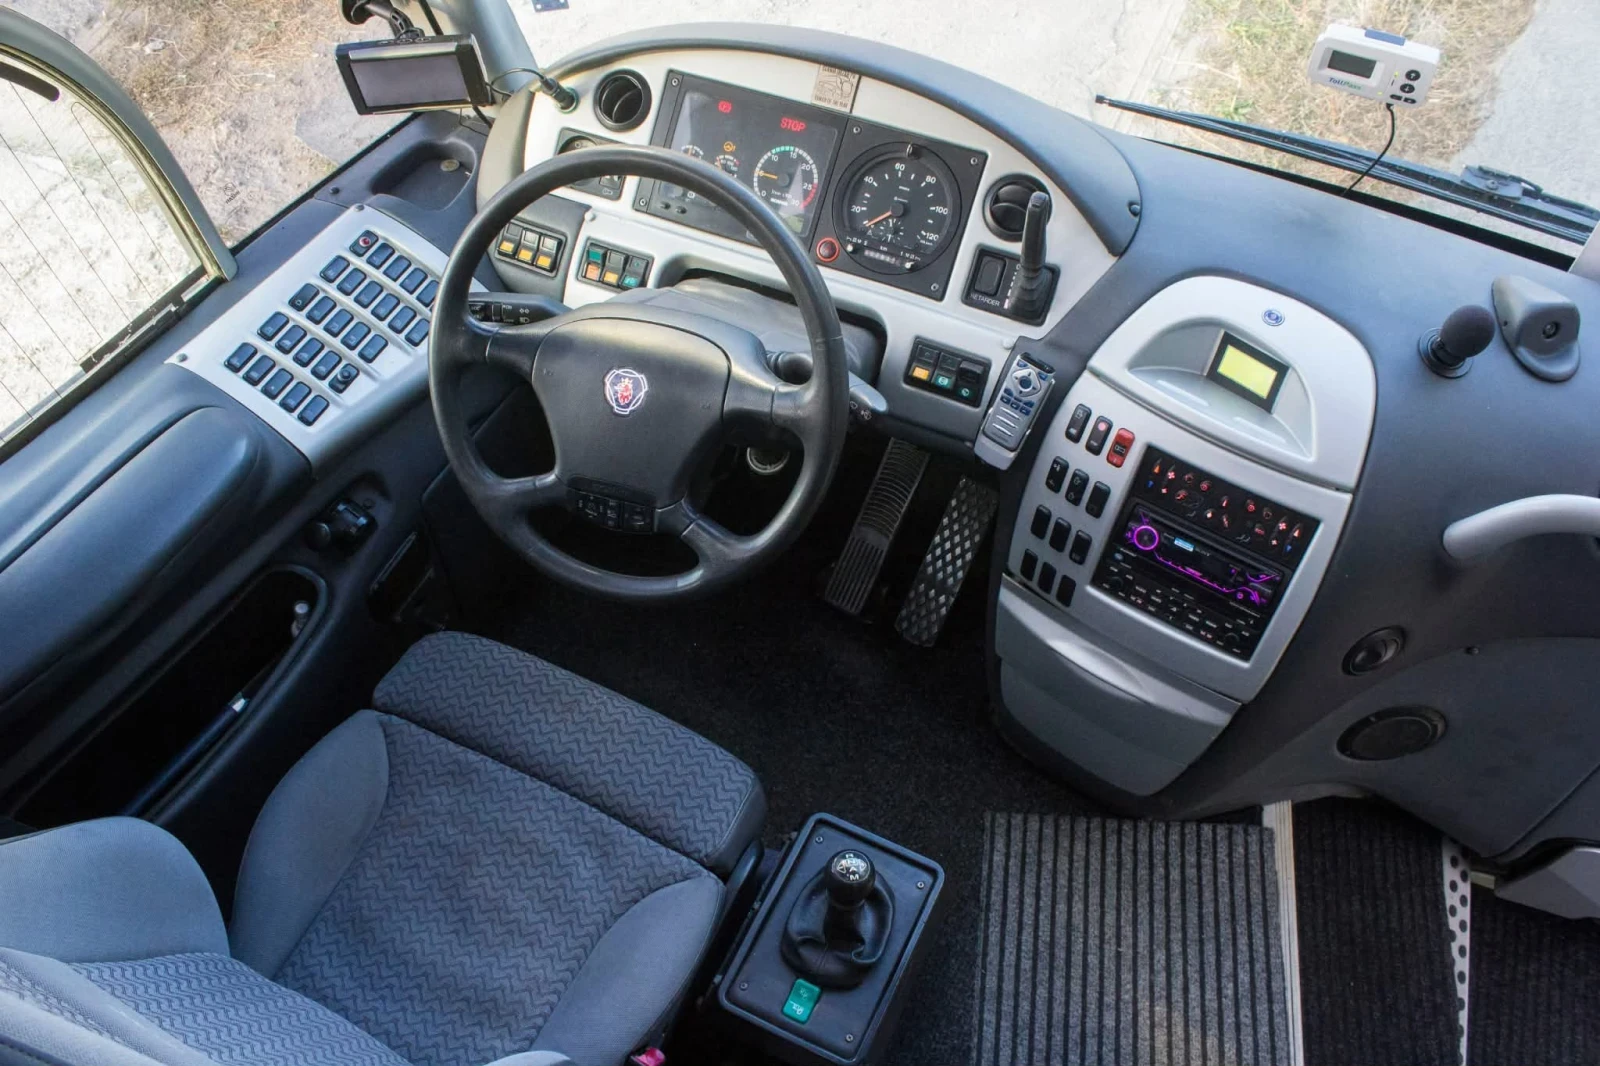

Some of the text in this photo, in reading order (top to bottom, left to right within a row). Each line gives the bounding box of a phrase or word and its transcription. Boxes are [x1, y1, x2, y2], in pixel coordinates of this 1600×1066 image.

[780, 117, 806, 132] STOP
[801, 163, 811, 171] 20
[894, 162, 905, 171] 60
[864, 176, 874, 184] 40
[925, 175, 937, 184] 80
[850, 205, 861, 213] 20
[935, 206, 949, 215] 100
[925, 232, 939, 241] 120
[849, 873, 859, 881] M
